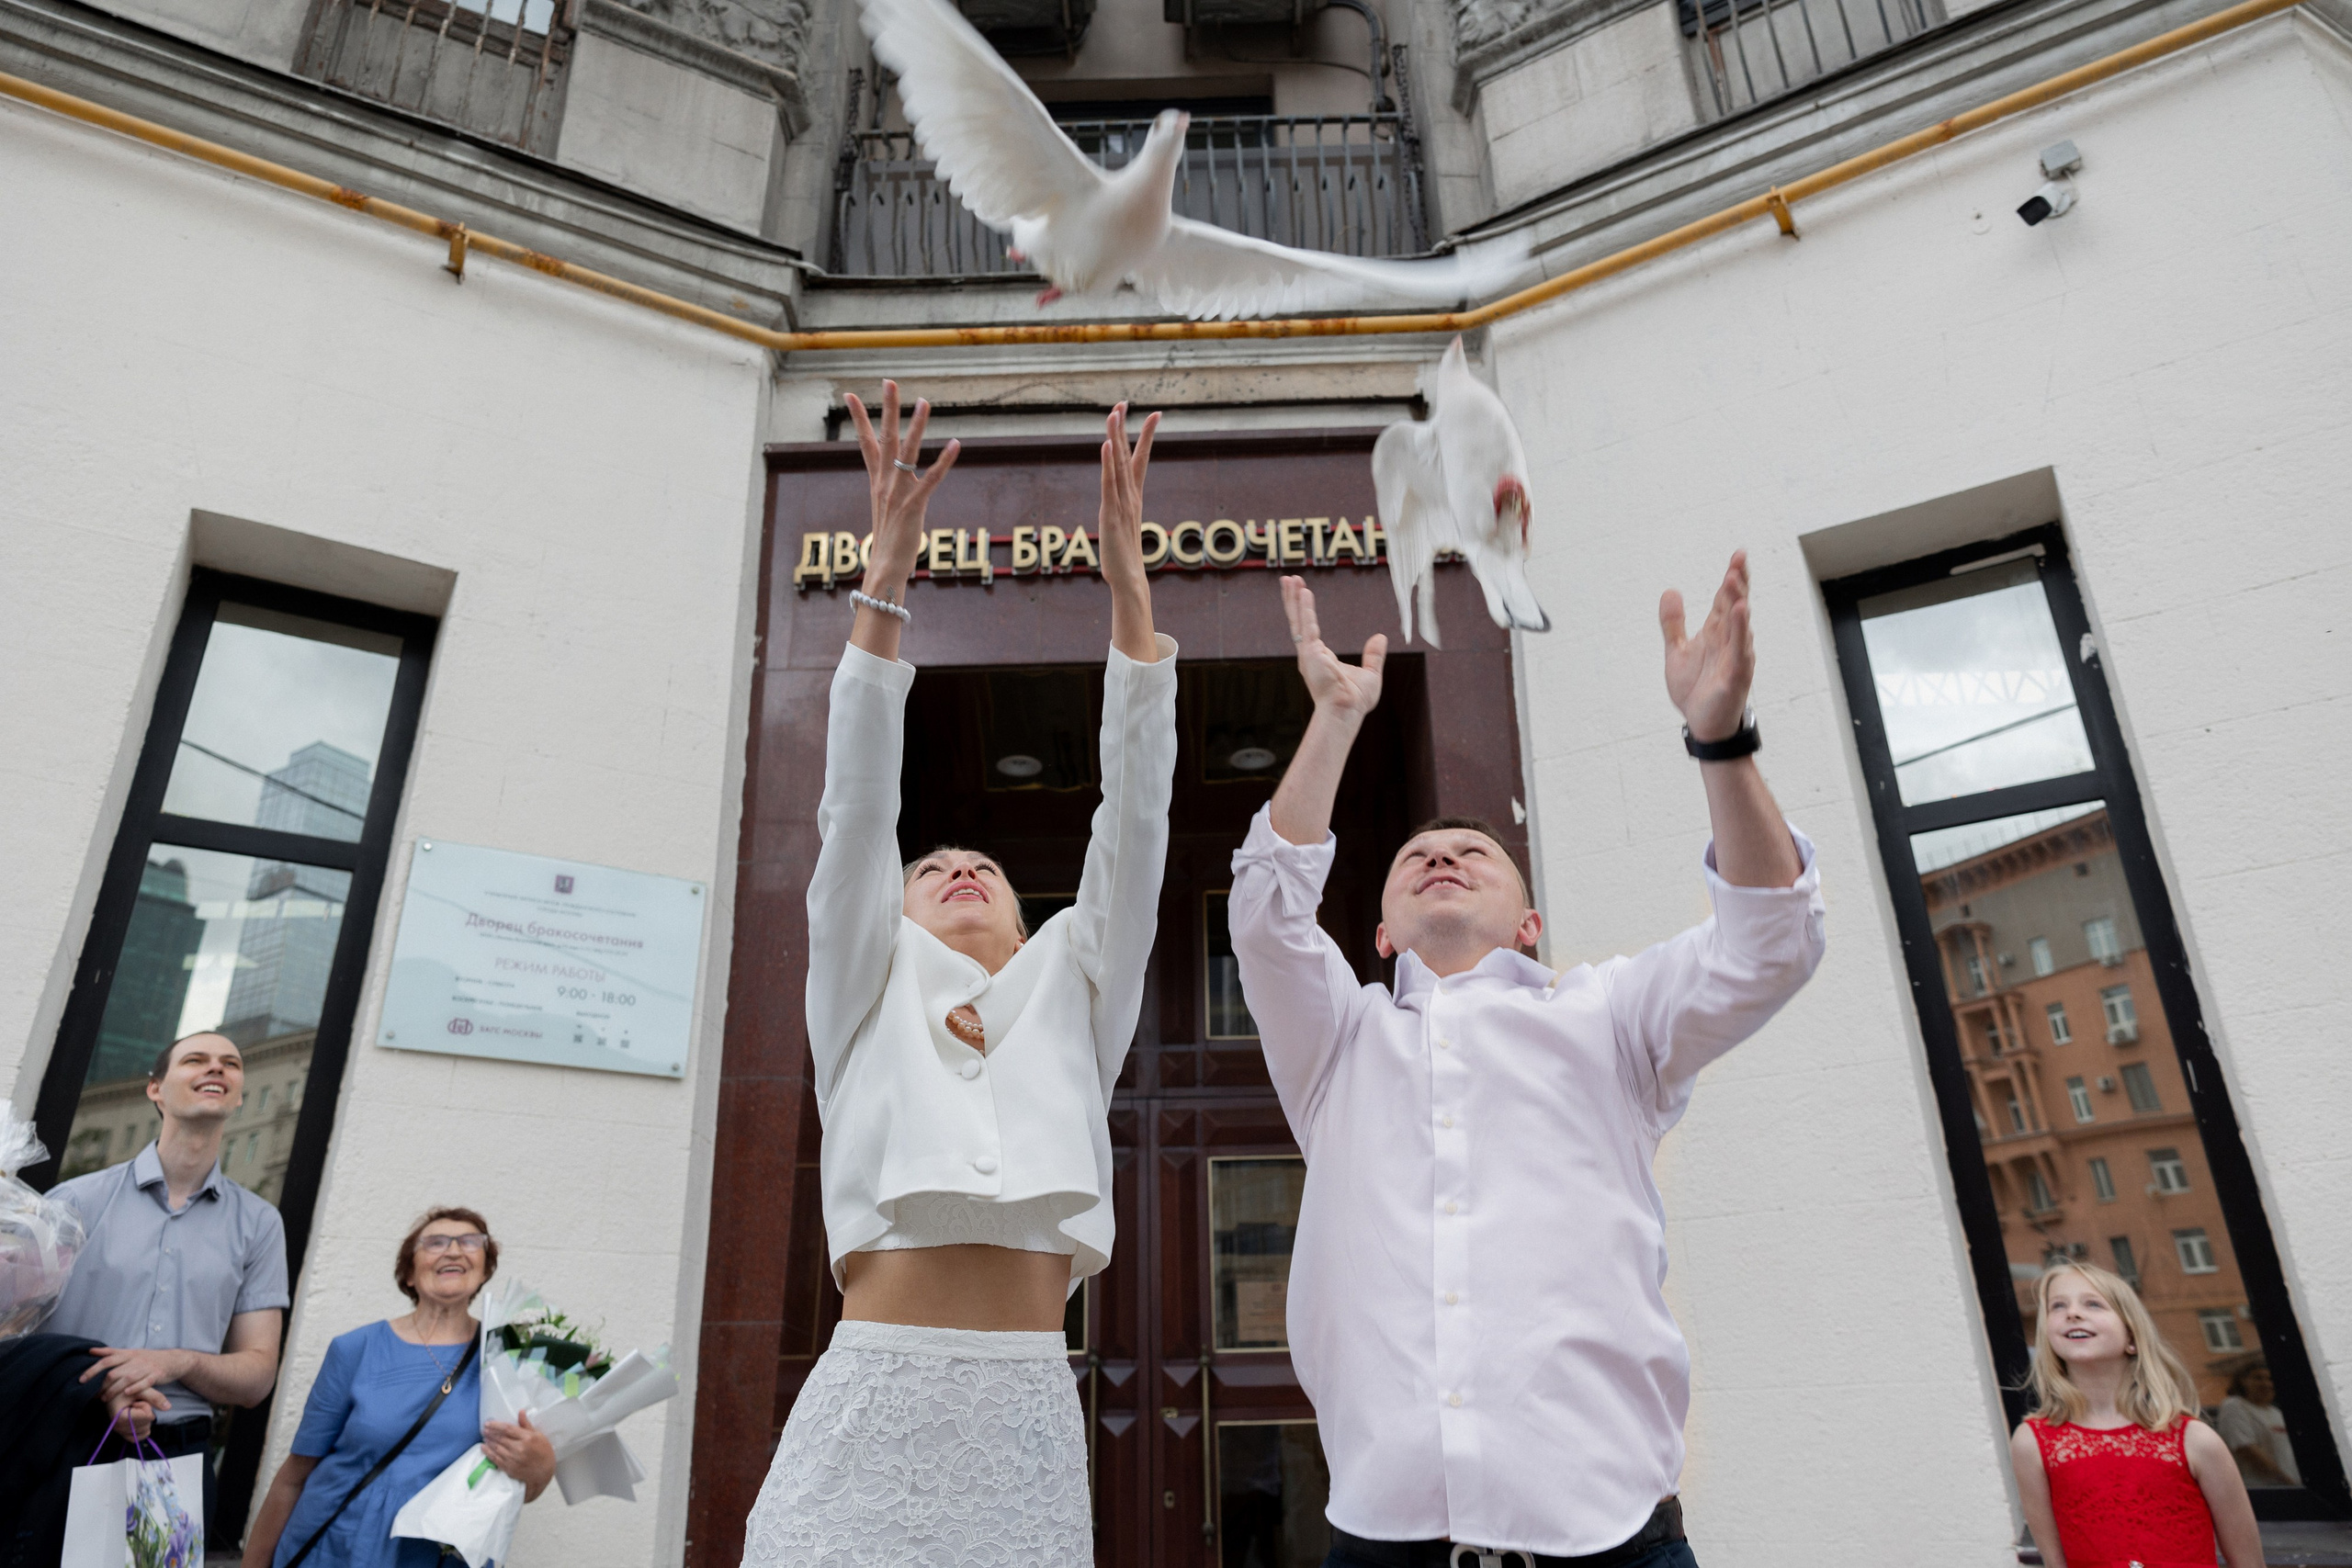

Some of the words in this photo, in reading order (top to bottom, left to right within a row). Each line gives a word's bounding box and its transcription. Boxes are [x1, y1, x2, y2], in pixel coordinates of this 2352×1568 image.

[793, 525, 992, 585] ДВЕЦ
[465, 912, 523, 934] Дворец
[526, 920, 643, 948] бракосочетания
[495, 956, 548, 974] РЕЖИМ
[551, 964, 606, 982] РАБОТЫ
[557, 986, 588, 1000] 9:00
[602, 991, 637, 1006] 18:00
